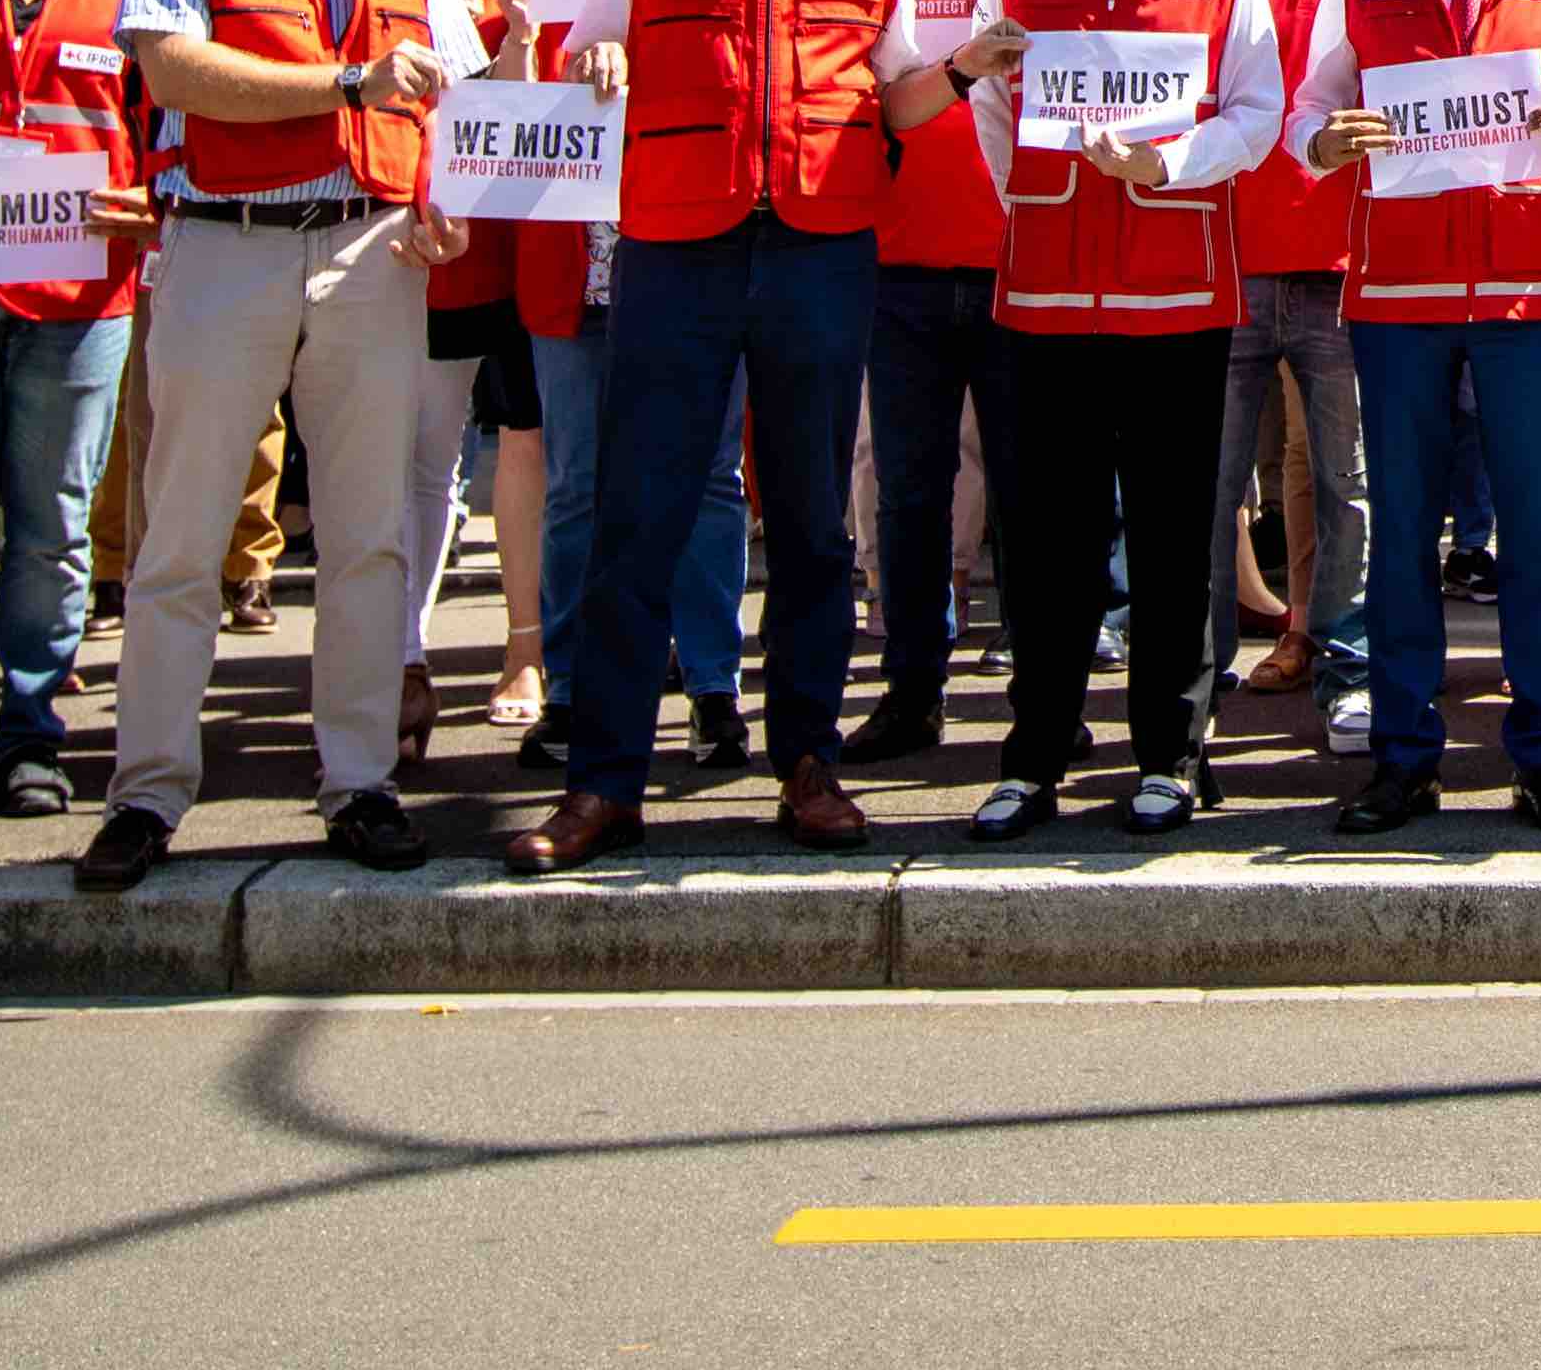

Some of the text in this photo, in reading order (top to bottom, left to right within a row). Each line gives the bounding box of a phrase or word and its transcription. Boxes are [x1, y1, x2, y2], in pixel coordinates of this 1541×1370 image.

[1041, 70, 1190, 103] WE MUST
[1383, 90, 1529, 136] WE MUST
[453, 121, 606, 159] WE MUST
[448, 159, 602, 180] #PROTECTHUMANITY
[2, 191, 92, 225] MUST
